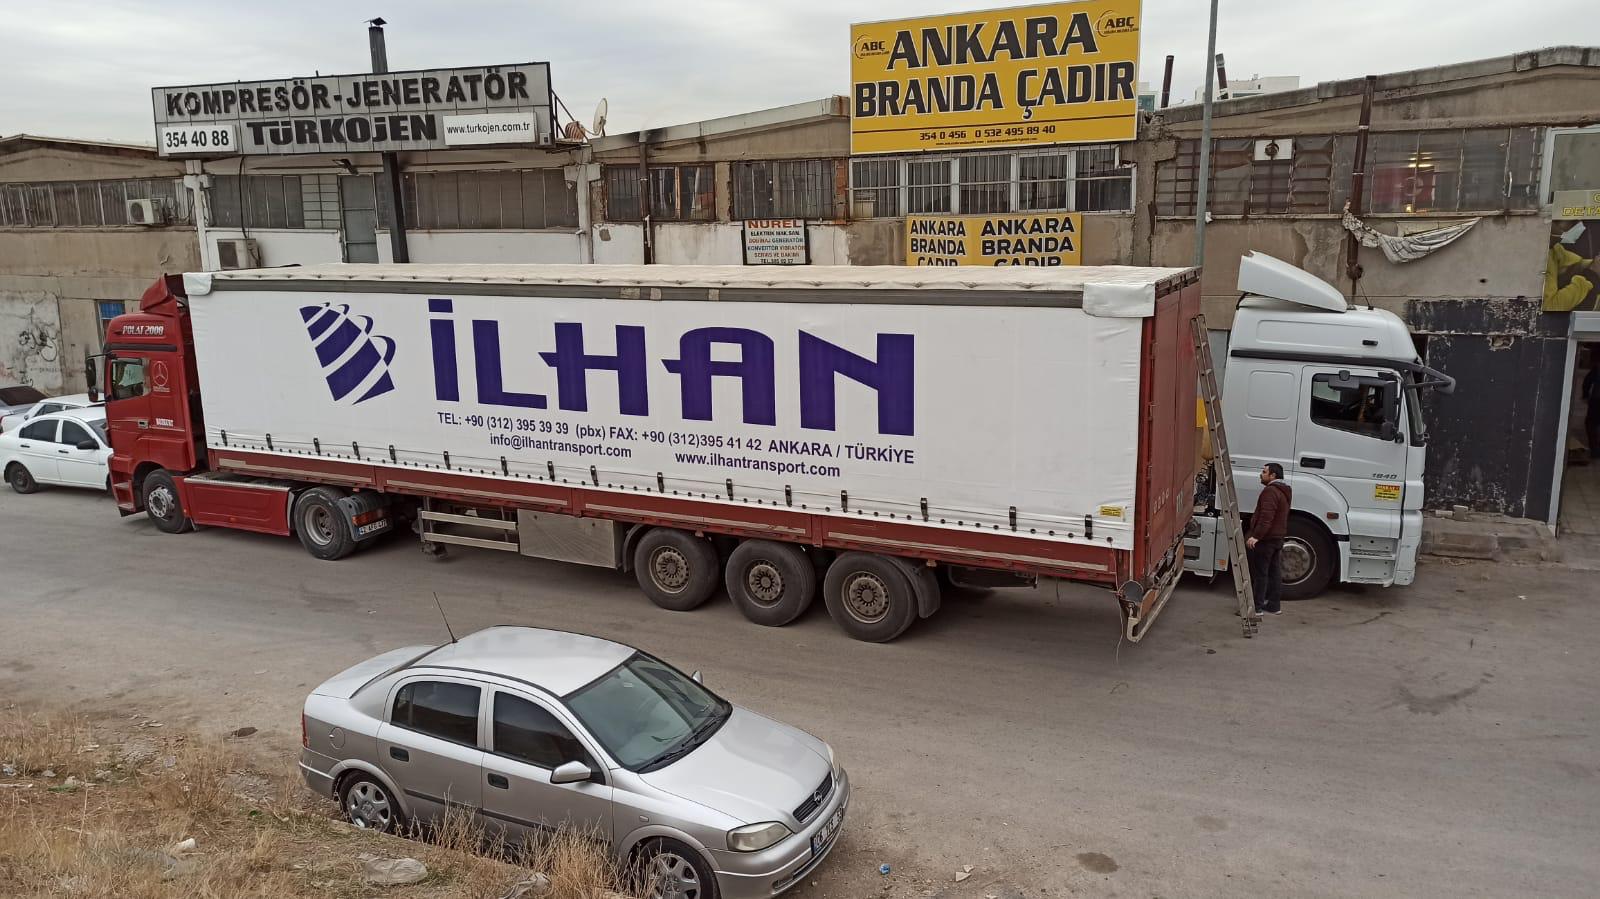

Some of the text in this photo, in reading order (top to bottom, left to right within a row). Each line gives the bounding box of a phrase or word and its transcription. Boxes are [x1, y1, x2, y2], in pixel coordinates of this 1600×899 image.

[887, 12, 1098, 70] ANKARA
[855, 61, 1136, 120] BRANDA ÇADIR
[447, 121, 531, 136] www.turkojen.com.tr
[920, 125, 1056, 141] 354 0 456 0 532 495 89 40
[165, 130, 229, 148] 354 40 88
[748, 219, 802, 229] NUREL
[910, 219, 966, 237] ANKARA
[981, 217, 1075, 237] ANKARA
[911, 238, 966, 255] BRANDA
[982, 236, 1074, 256] BRANDA
[428, 299, 915, 436] İLHAN
[437, 411, 462, 426] TEL:
[465, 415, 484, 427] +90
[487, 416, 514, 432] (312)
[517, 418, 536, 432] 395
[539, 420, 552, 433] 39
[556, 421, 569, 435] 39
[576, 423, 606, 441] (pbx)
[610, 426, 638, 441] FAX:
[642, 430, 665, 444] +90
[727, 436, 741, 449] 41
[746, 438, 762, 451] 42
[768, 439, 832, 458] ANKARA
[845, 442, 914, 464] TÜRKİYE
[490, 433, 632, 458] info@ilhantransport.com
[675, 451, 841, 477] www.ilhantransport.com
